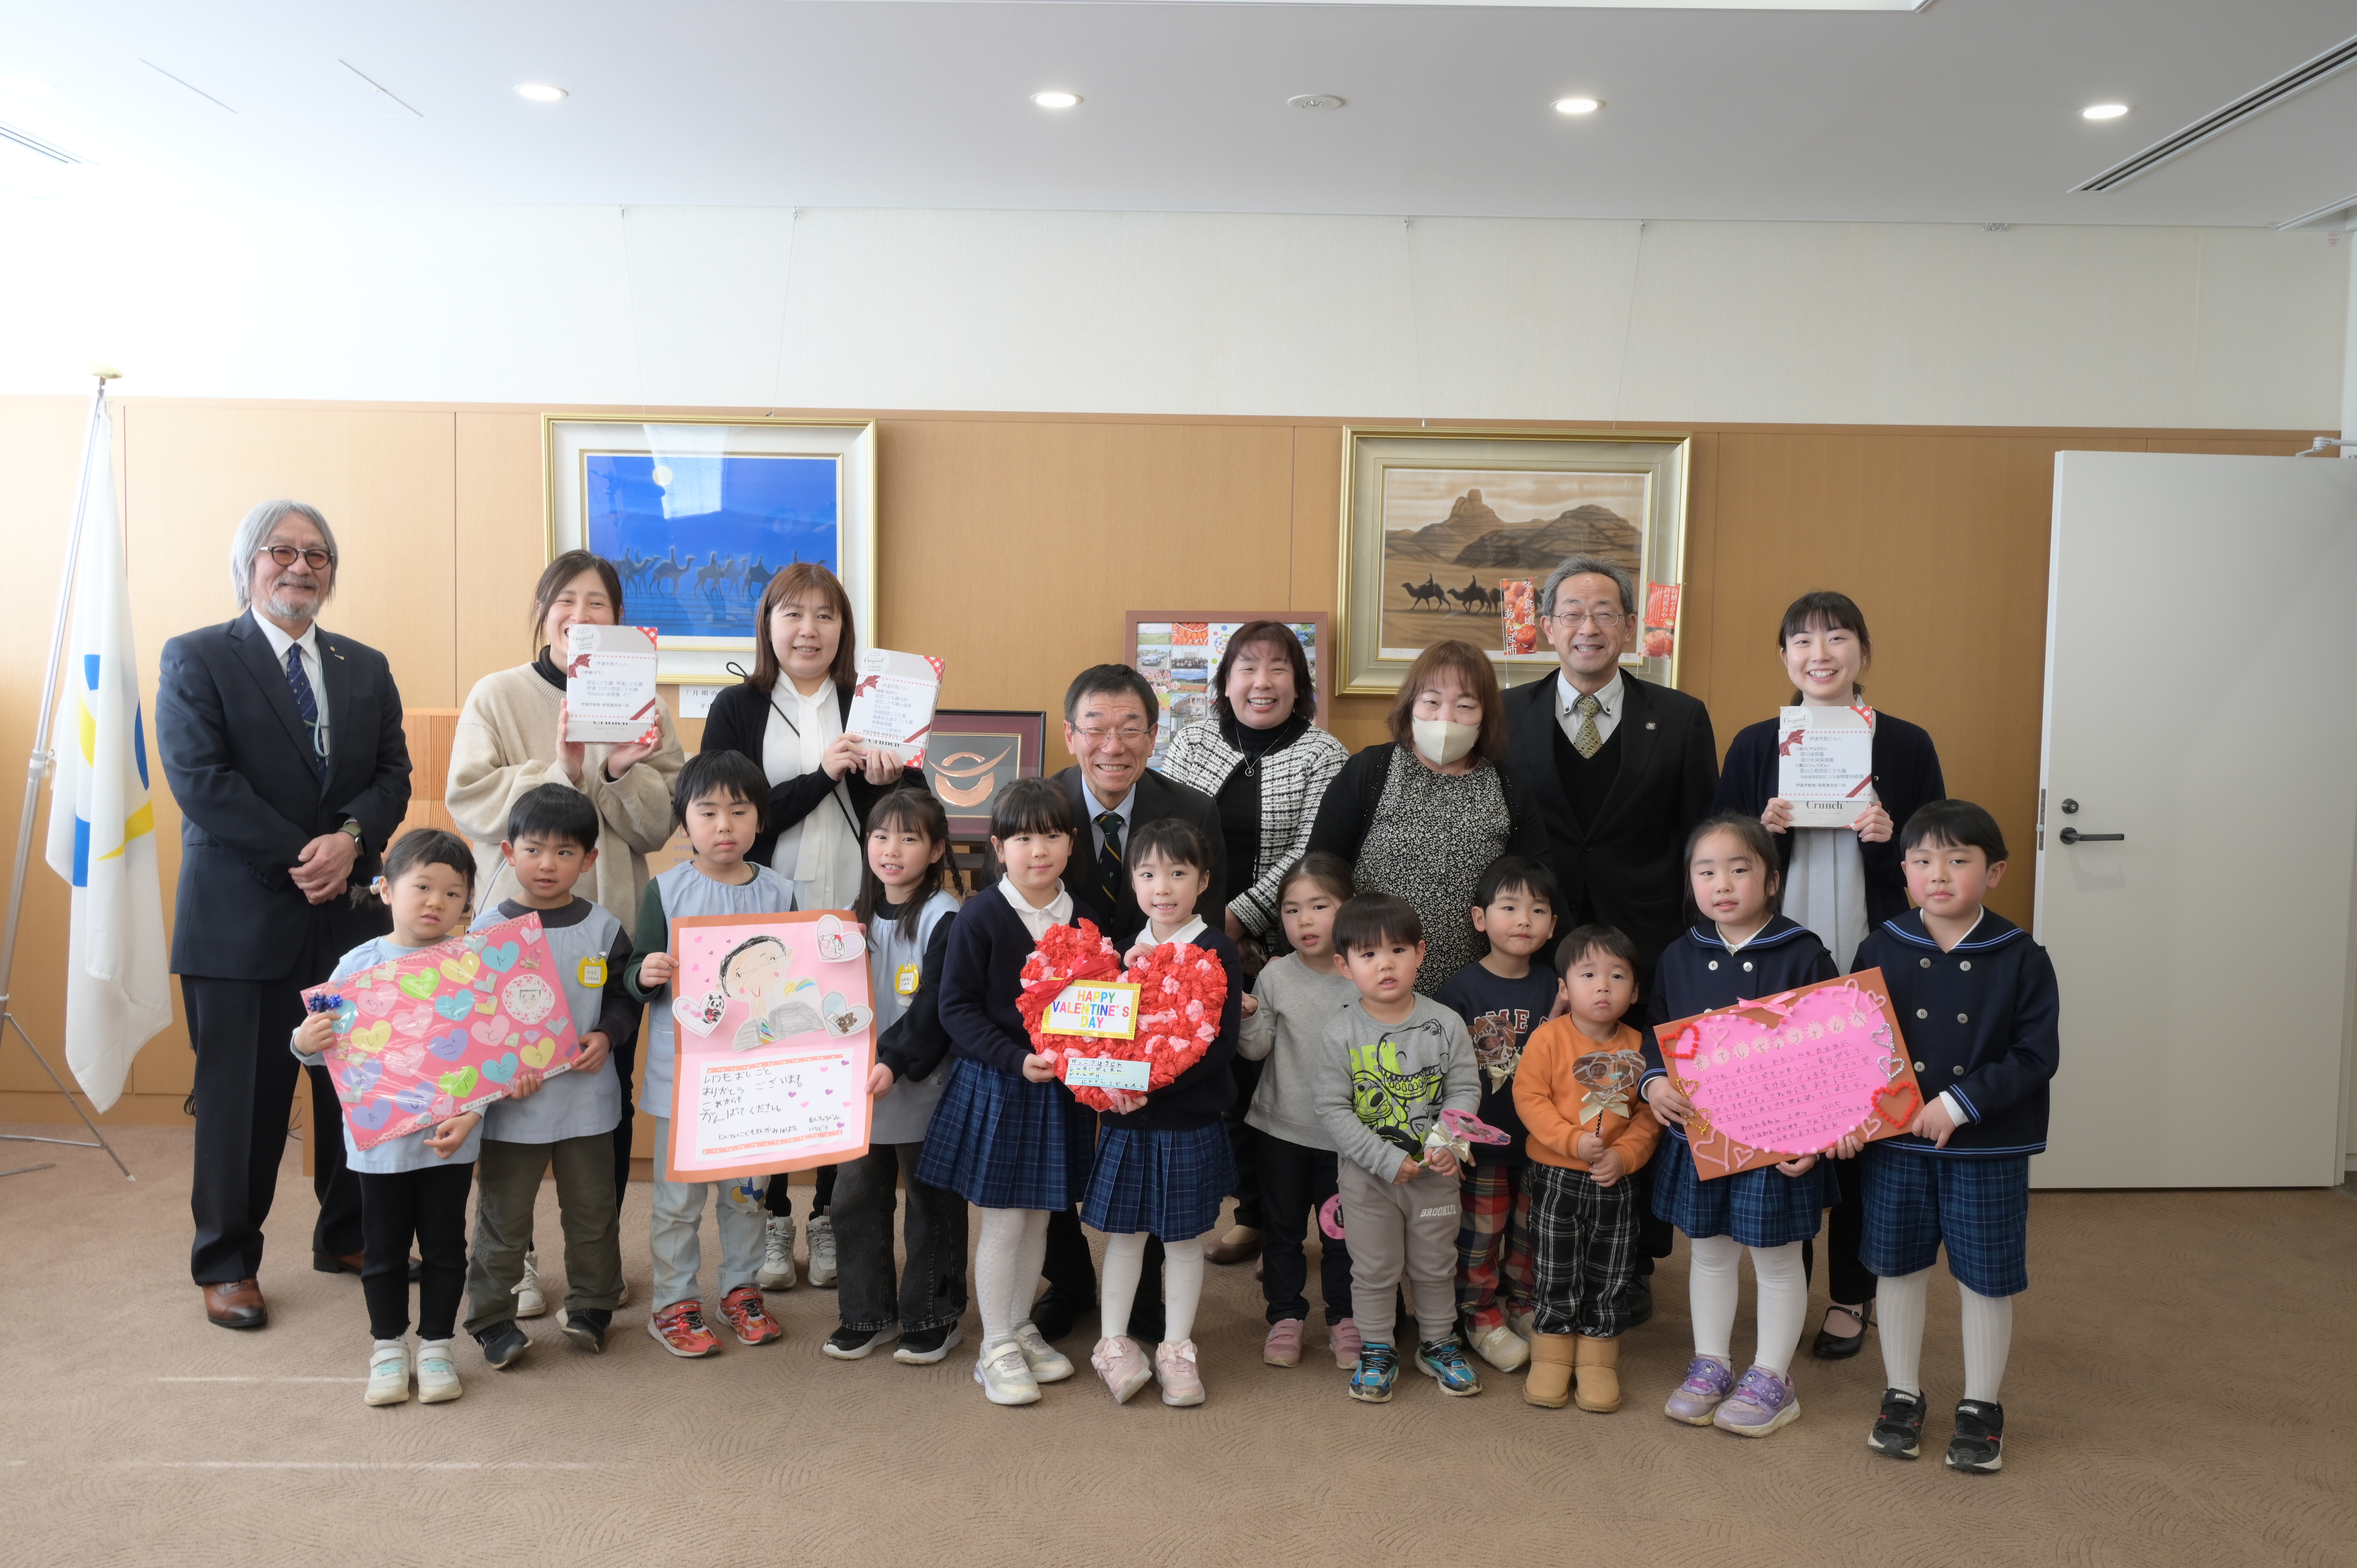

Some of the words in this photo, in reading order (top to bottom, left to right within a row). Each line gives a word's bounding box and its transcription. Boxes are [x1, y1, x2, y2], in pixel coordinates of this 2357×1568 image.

[1523, 581, 1535, 626] 冬の食べ頃
[1661, 588, 1670, 627] 自然派おやつ。
[1670, 588, 1678, 617] 砂糖ゼロの
[1504, 608, 1517, 655] あんぽ柿
[1784, 714, 1806, 725] Original
[1806, 801, 1842, 809] Crunch
[1077, 990, 1115, 1003] HAPPY
[1053, 1001, 1129, 1017] VALENTINE'S
[1080, 1015, 1104, 1028] DAY
